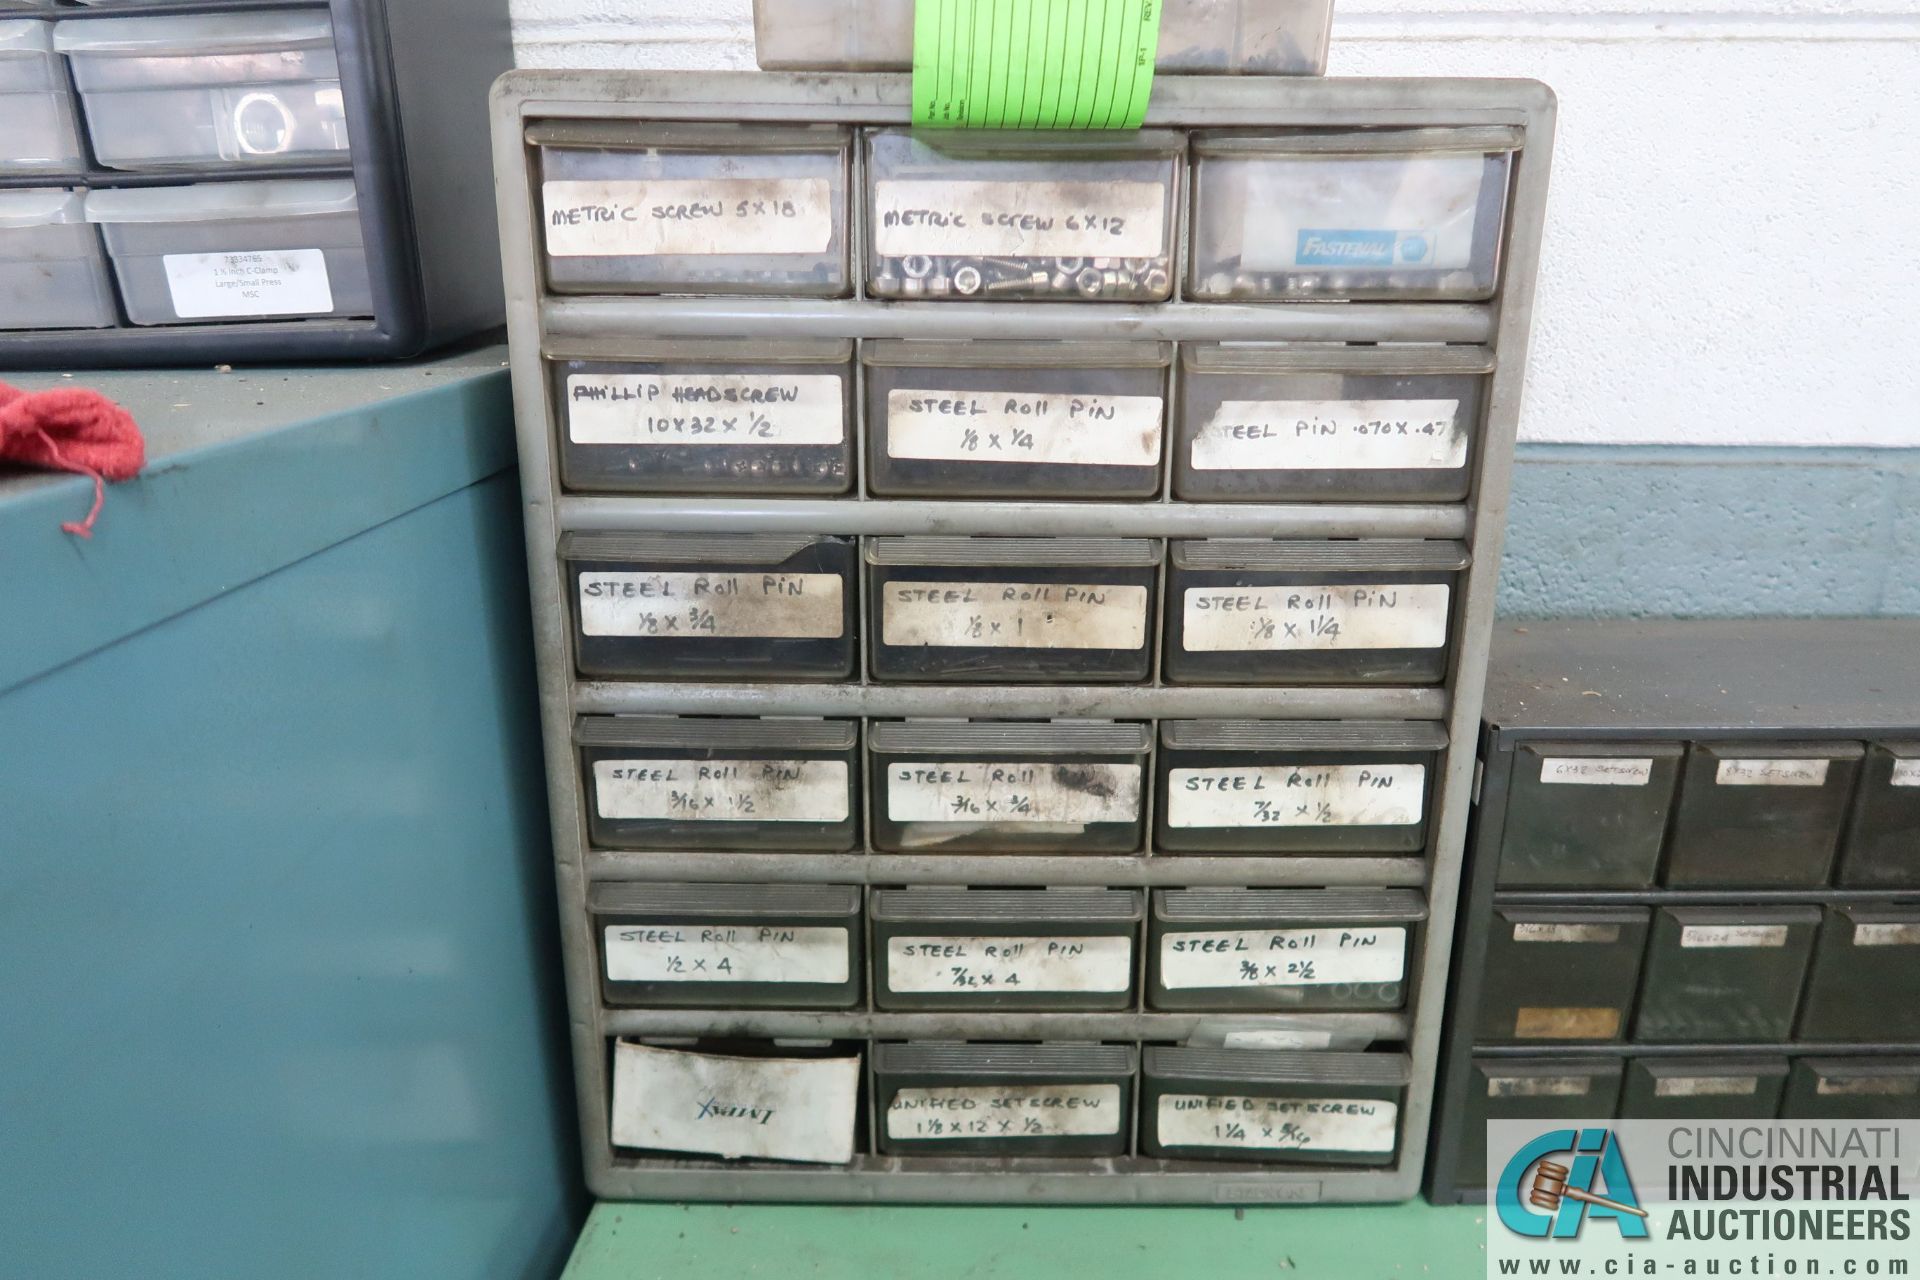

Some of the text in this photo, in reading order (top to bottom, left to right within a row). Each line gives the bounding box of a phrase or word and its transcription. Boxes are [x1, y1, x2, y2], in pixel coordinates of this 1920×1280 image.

[651, 201, 724, 219] SCREW
[981, 212, 1054, 231] SCREW
[241, 290, 260, 298] MSC
[909, 399, 987, 416] STEEL
[584, 580, 675, 599] STEEL
[897, 588, 979, 604] STEEL
[1195, 595, 1268, 612] STEEL
[612, 768, 678, 782] STEEL
[899, 769, 971, 784] STEEL
[1185, 774, 1266, 791] STEEL
[619, 930, 686, 943] STEEL
[903, 943, 967, 958] STEEL
[1172, 937, 1249, 953] STEEL
